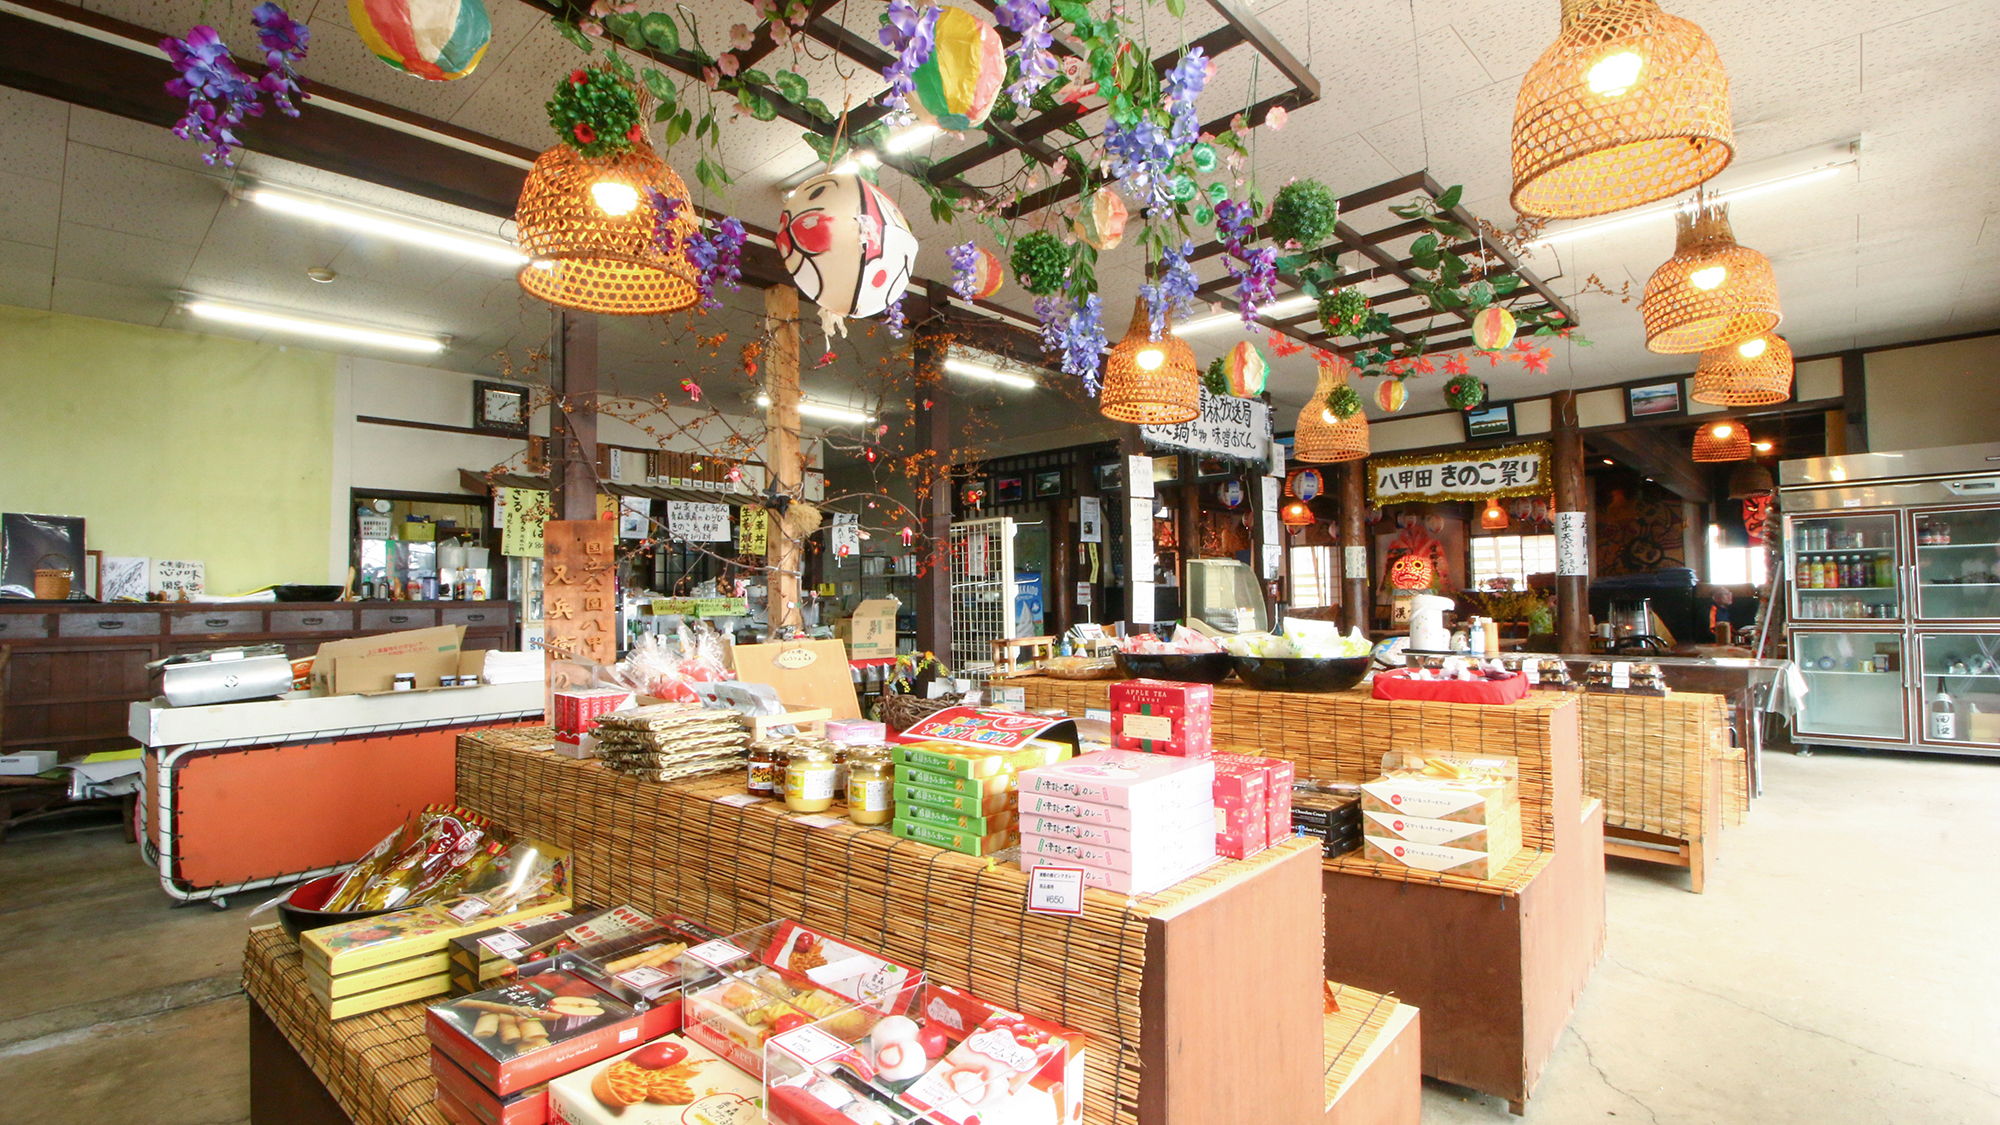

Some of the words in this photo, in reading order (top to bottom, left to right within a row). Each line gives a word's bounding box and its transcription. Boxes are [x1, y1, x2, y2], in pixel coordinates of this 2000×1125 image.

[1212, 427, 1256, 449] 味噌おでん
[1379, 469, 1433, 490] 八甲田
[1441, 460, 1539, 488] きのこ祭り
[581, 542, 607, 663] 国立公園八甲
[1125, 689, 1150, 697] APPLE
[1153, 690, 1167, 698] TEA
[1046, 895, 1065, 904] ¥650
[688, 1016, 725, 1049] Platinum
